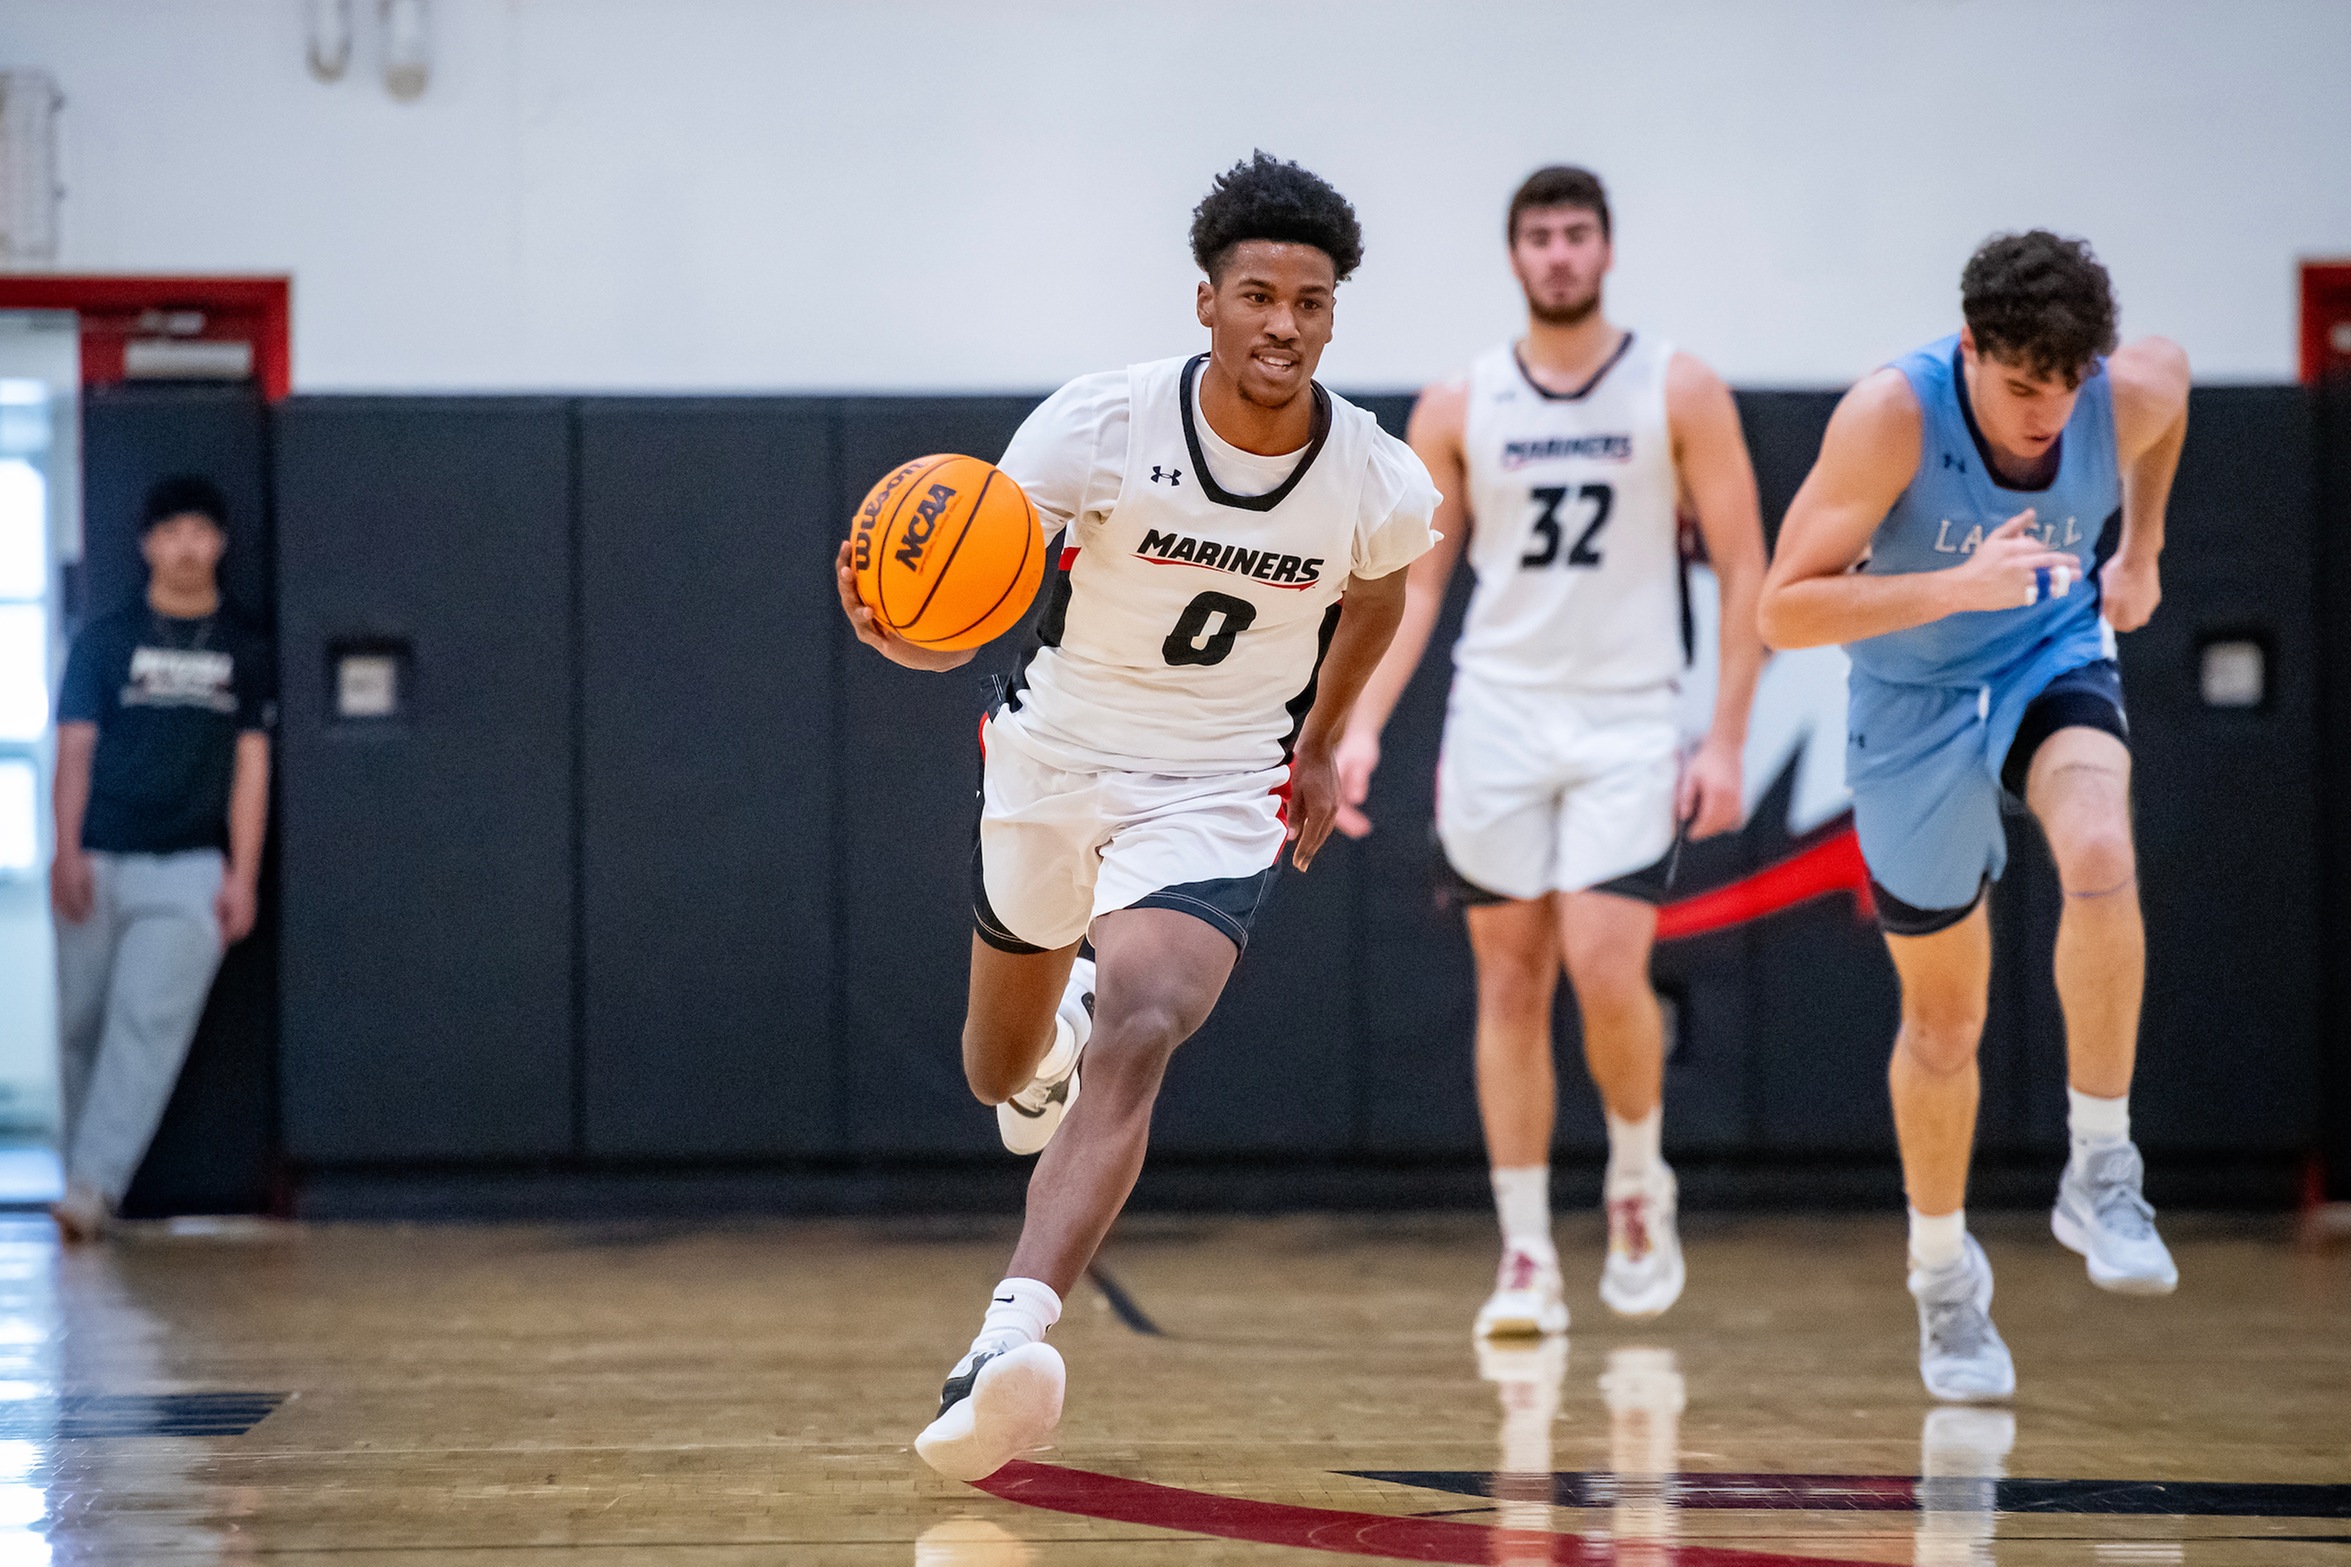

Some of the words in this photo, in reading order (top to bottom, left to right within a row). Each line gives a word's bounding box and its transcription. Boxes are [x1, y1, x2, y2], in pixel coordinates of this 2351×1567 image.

[895, 483, 957, 573] NCAA
[1136, 528, 1325, 583] MARINERS
[1520, 483, 1614, 568] 32
[1934, 515, 2083, 554] LALL
[1161, 591, 1257, 666] 0
